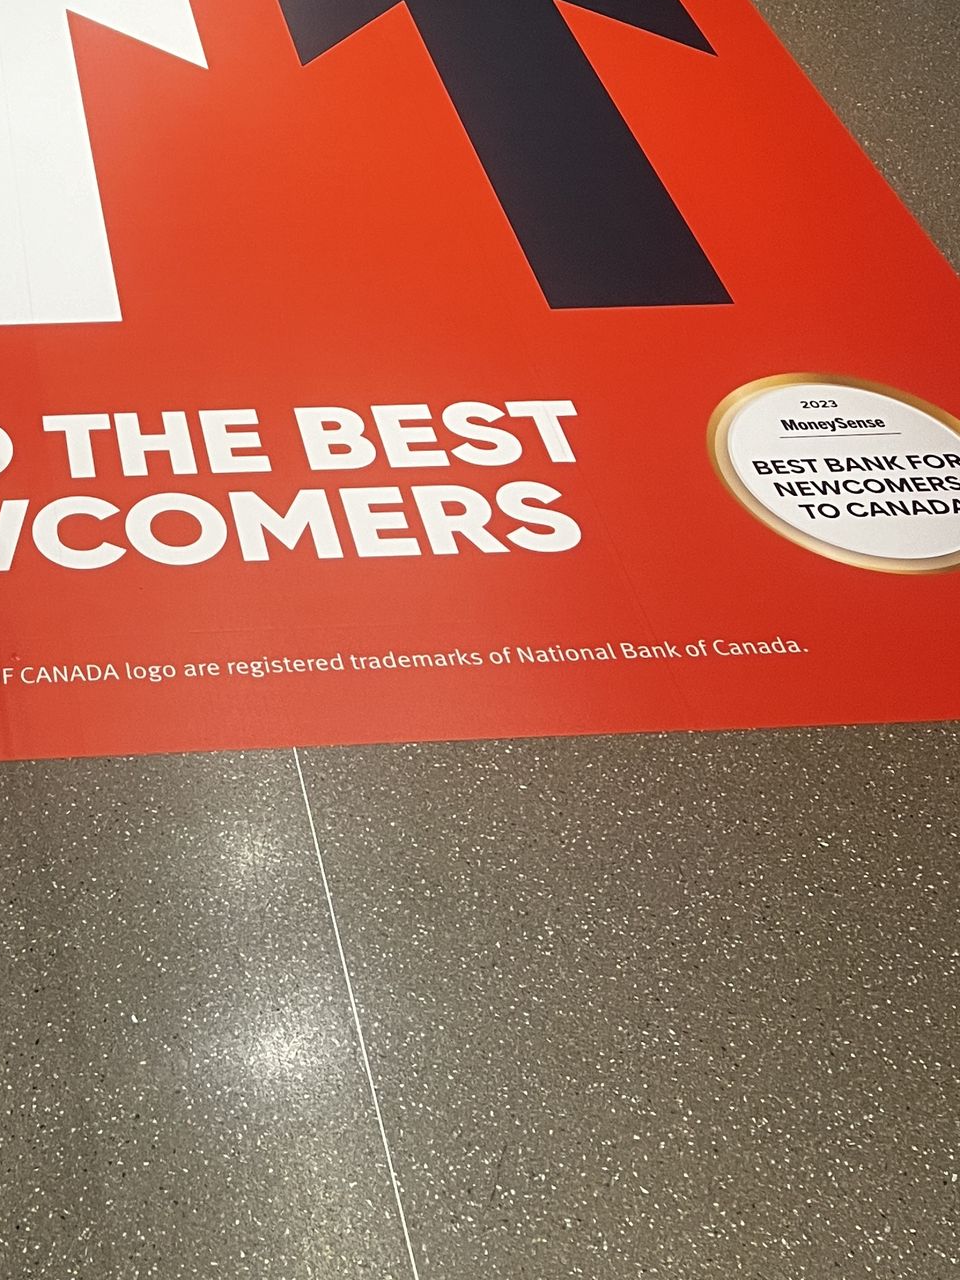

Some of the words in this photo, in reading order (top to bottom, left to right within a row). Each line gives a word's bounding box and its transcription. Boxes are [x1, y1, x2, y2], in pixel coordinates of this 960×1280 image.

[800, 400, 838, 409] 2023
[780, 417, 886, 432] MoneySense
[42, 409, 272, 479] THE
[294, 400, 578, 471] BEST
[752, 459, 818, 475] BEST
[824, 455, 906, 473] BANK
[905, 453, 960, 469] FOR
[773, 475, 960, 497] NEWCOMERS
[798, 503, 841, 520] TO
[20, 663, 120, 684] CANADA
[125, 662, 177, 683] logo
[184, 662, 221, 677] are
[227, 653, 345, 679] registered
[350, 649, 484, 671] trademarks
[489, 647, 511, 665] of
[517, 643, 617, 663] National
[620, 641, 682, 659] Bank
[686, 640, 708, 657] of
[713, 637, 809, 655] Canada.
